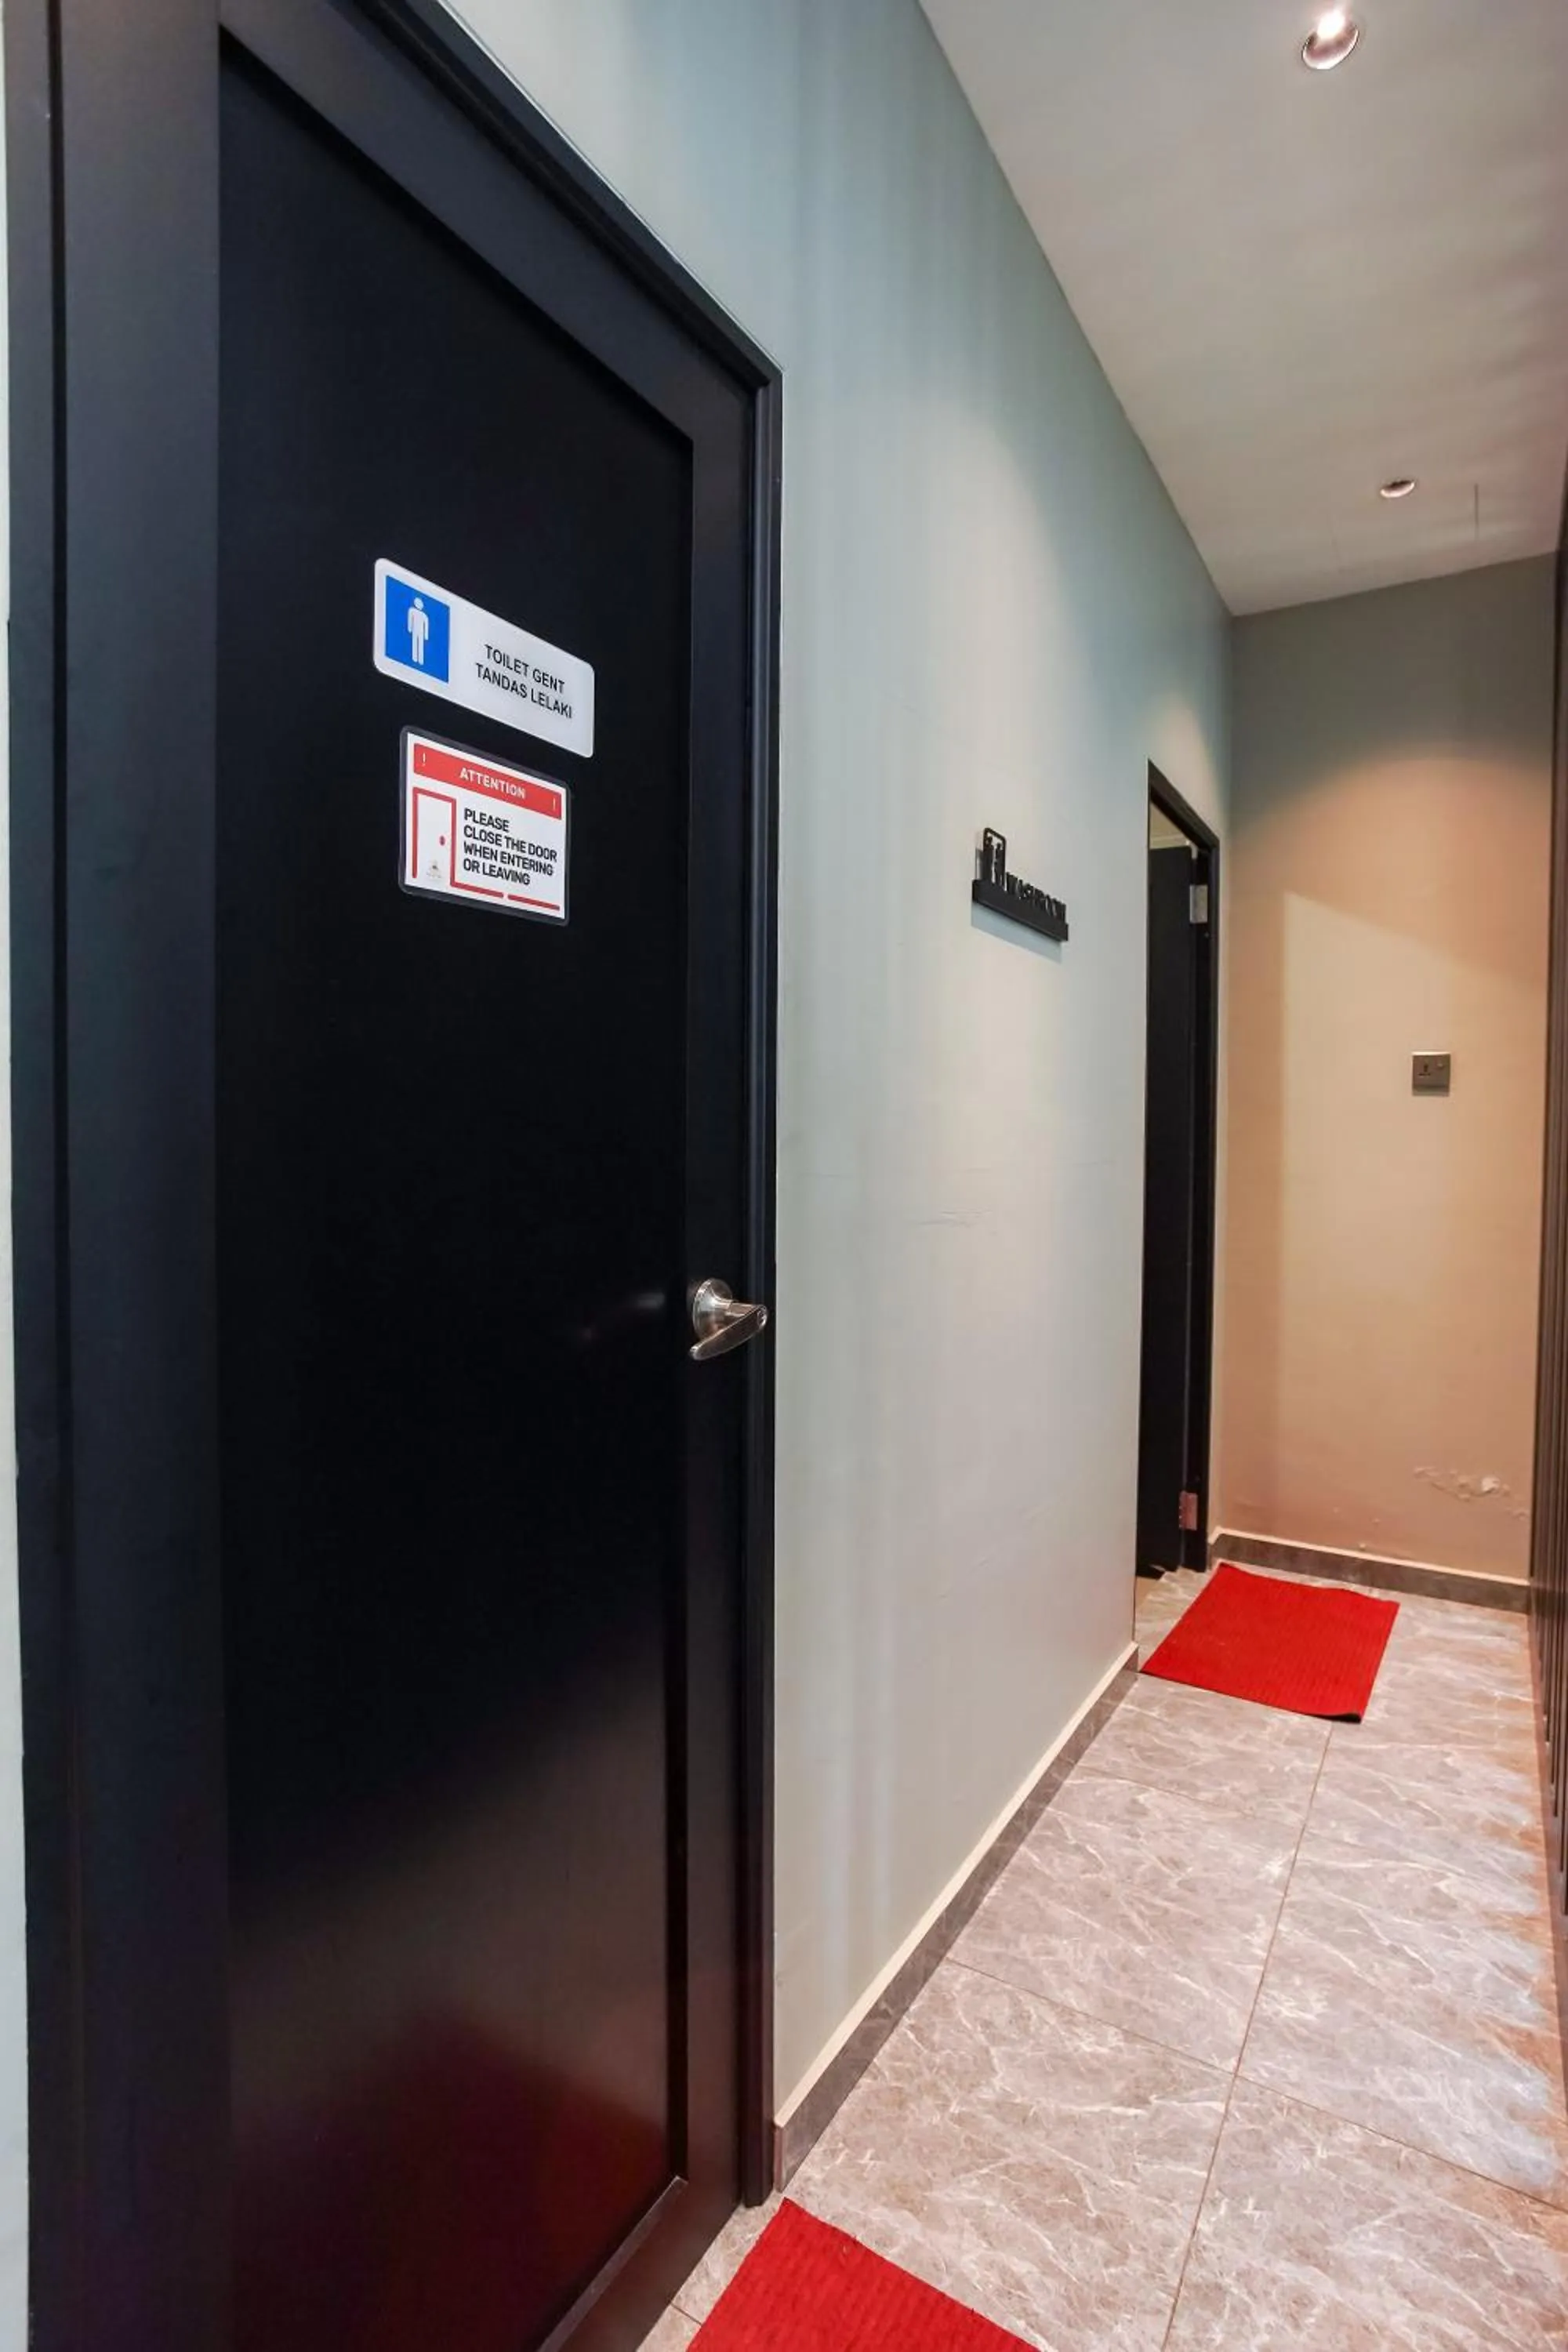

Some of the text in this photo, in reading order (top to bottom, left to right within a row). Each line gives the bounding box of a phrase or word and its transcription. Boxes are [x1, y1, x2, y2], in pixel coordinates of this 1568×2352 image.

[485, 644, 565, 694] TOILET GENT
[475, 663, 572, 719] TANDAS LELAKI
[459, 768, 525, 799] ATTENTION
[464, 808, 510, 833] PLEASE
[463, 826, 557, 862] CLOSE THE DOOR
[463, 842, 554, 877] WHEN ENTERING
[463, 858, 531, 886] OR LEAVING
